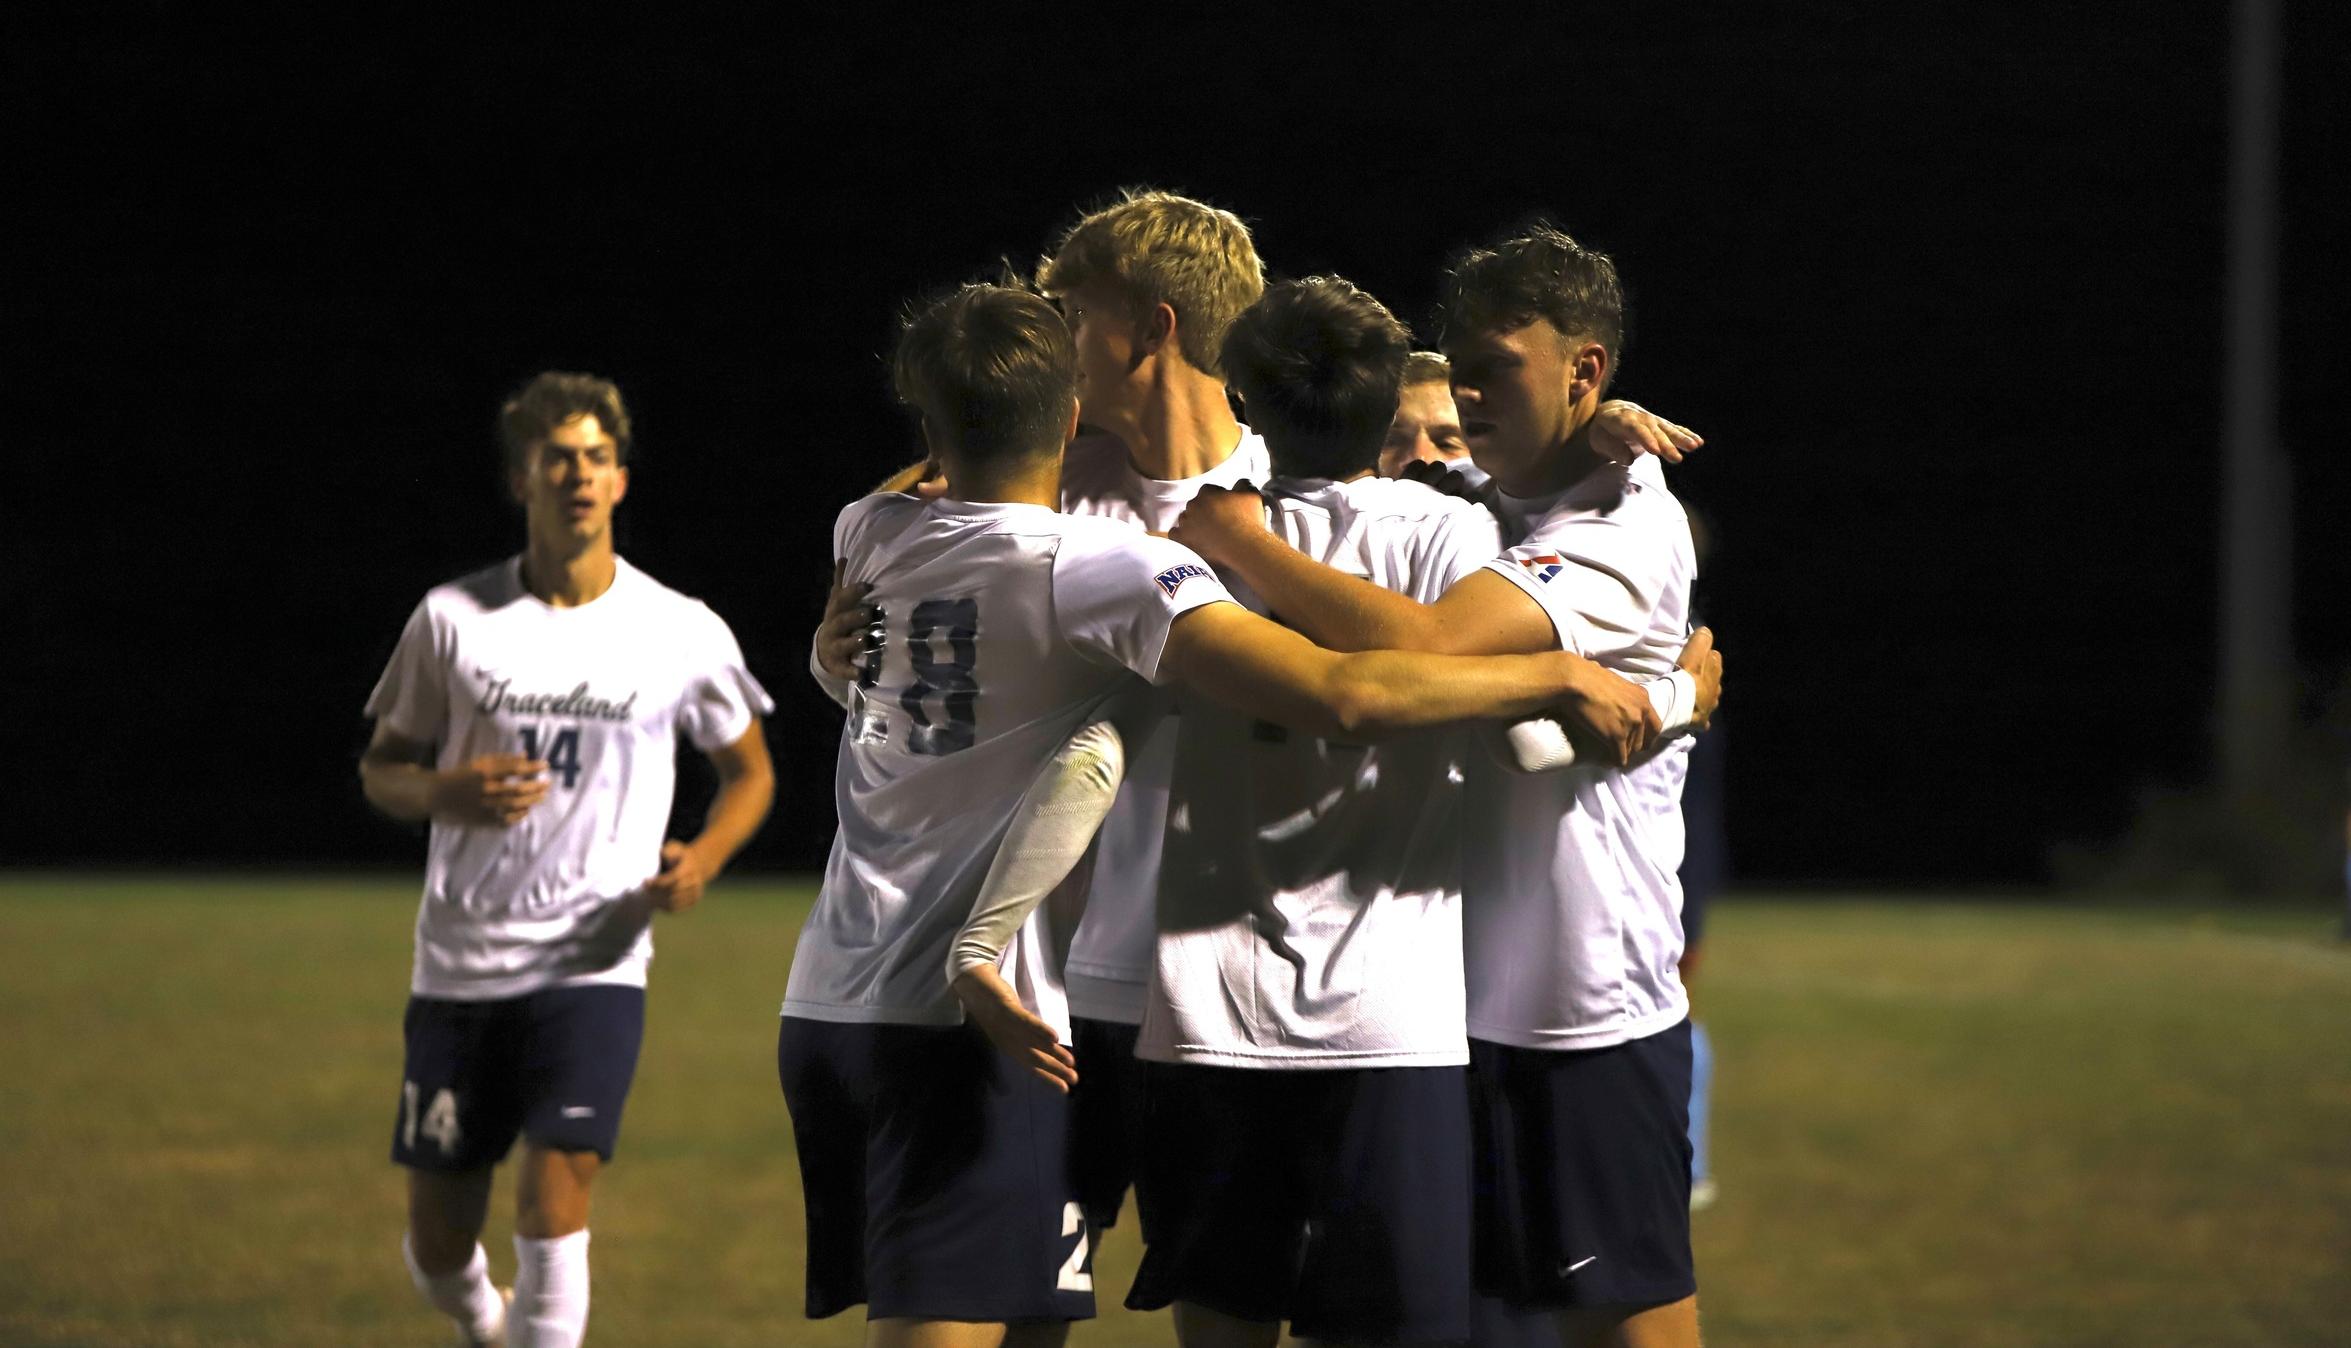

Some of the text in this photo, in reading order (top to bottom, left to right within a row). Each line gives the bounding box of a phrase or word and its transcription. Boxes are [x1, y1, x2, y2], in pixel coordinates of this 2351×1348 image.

[519, 725, 581, 788] 14
[403, 1080, 459, 1152] 14
[1056, 1201, 1093, 1292] 2
